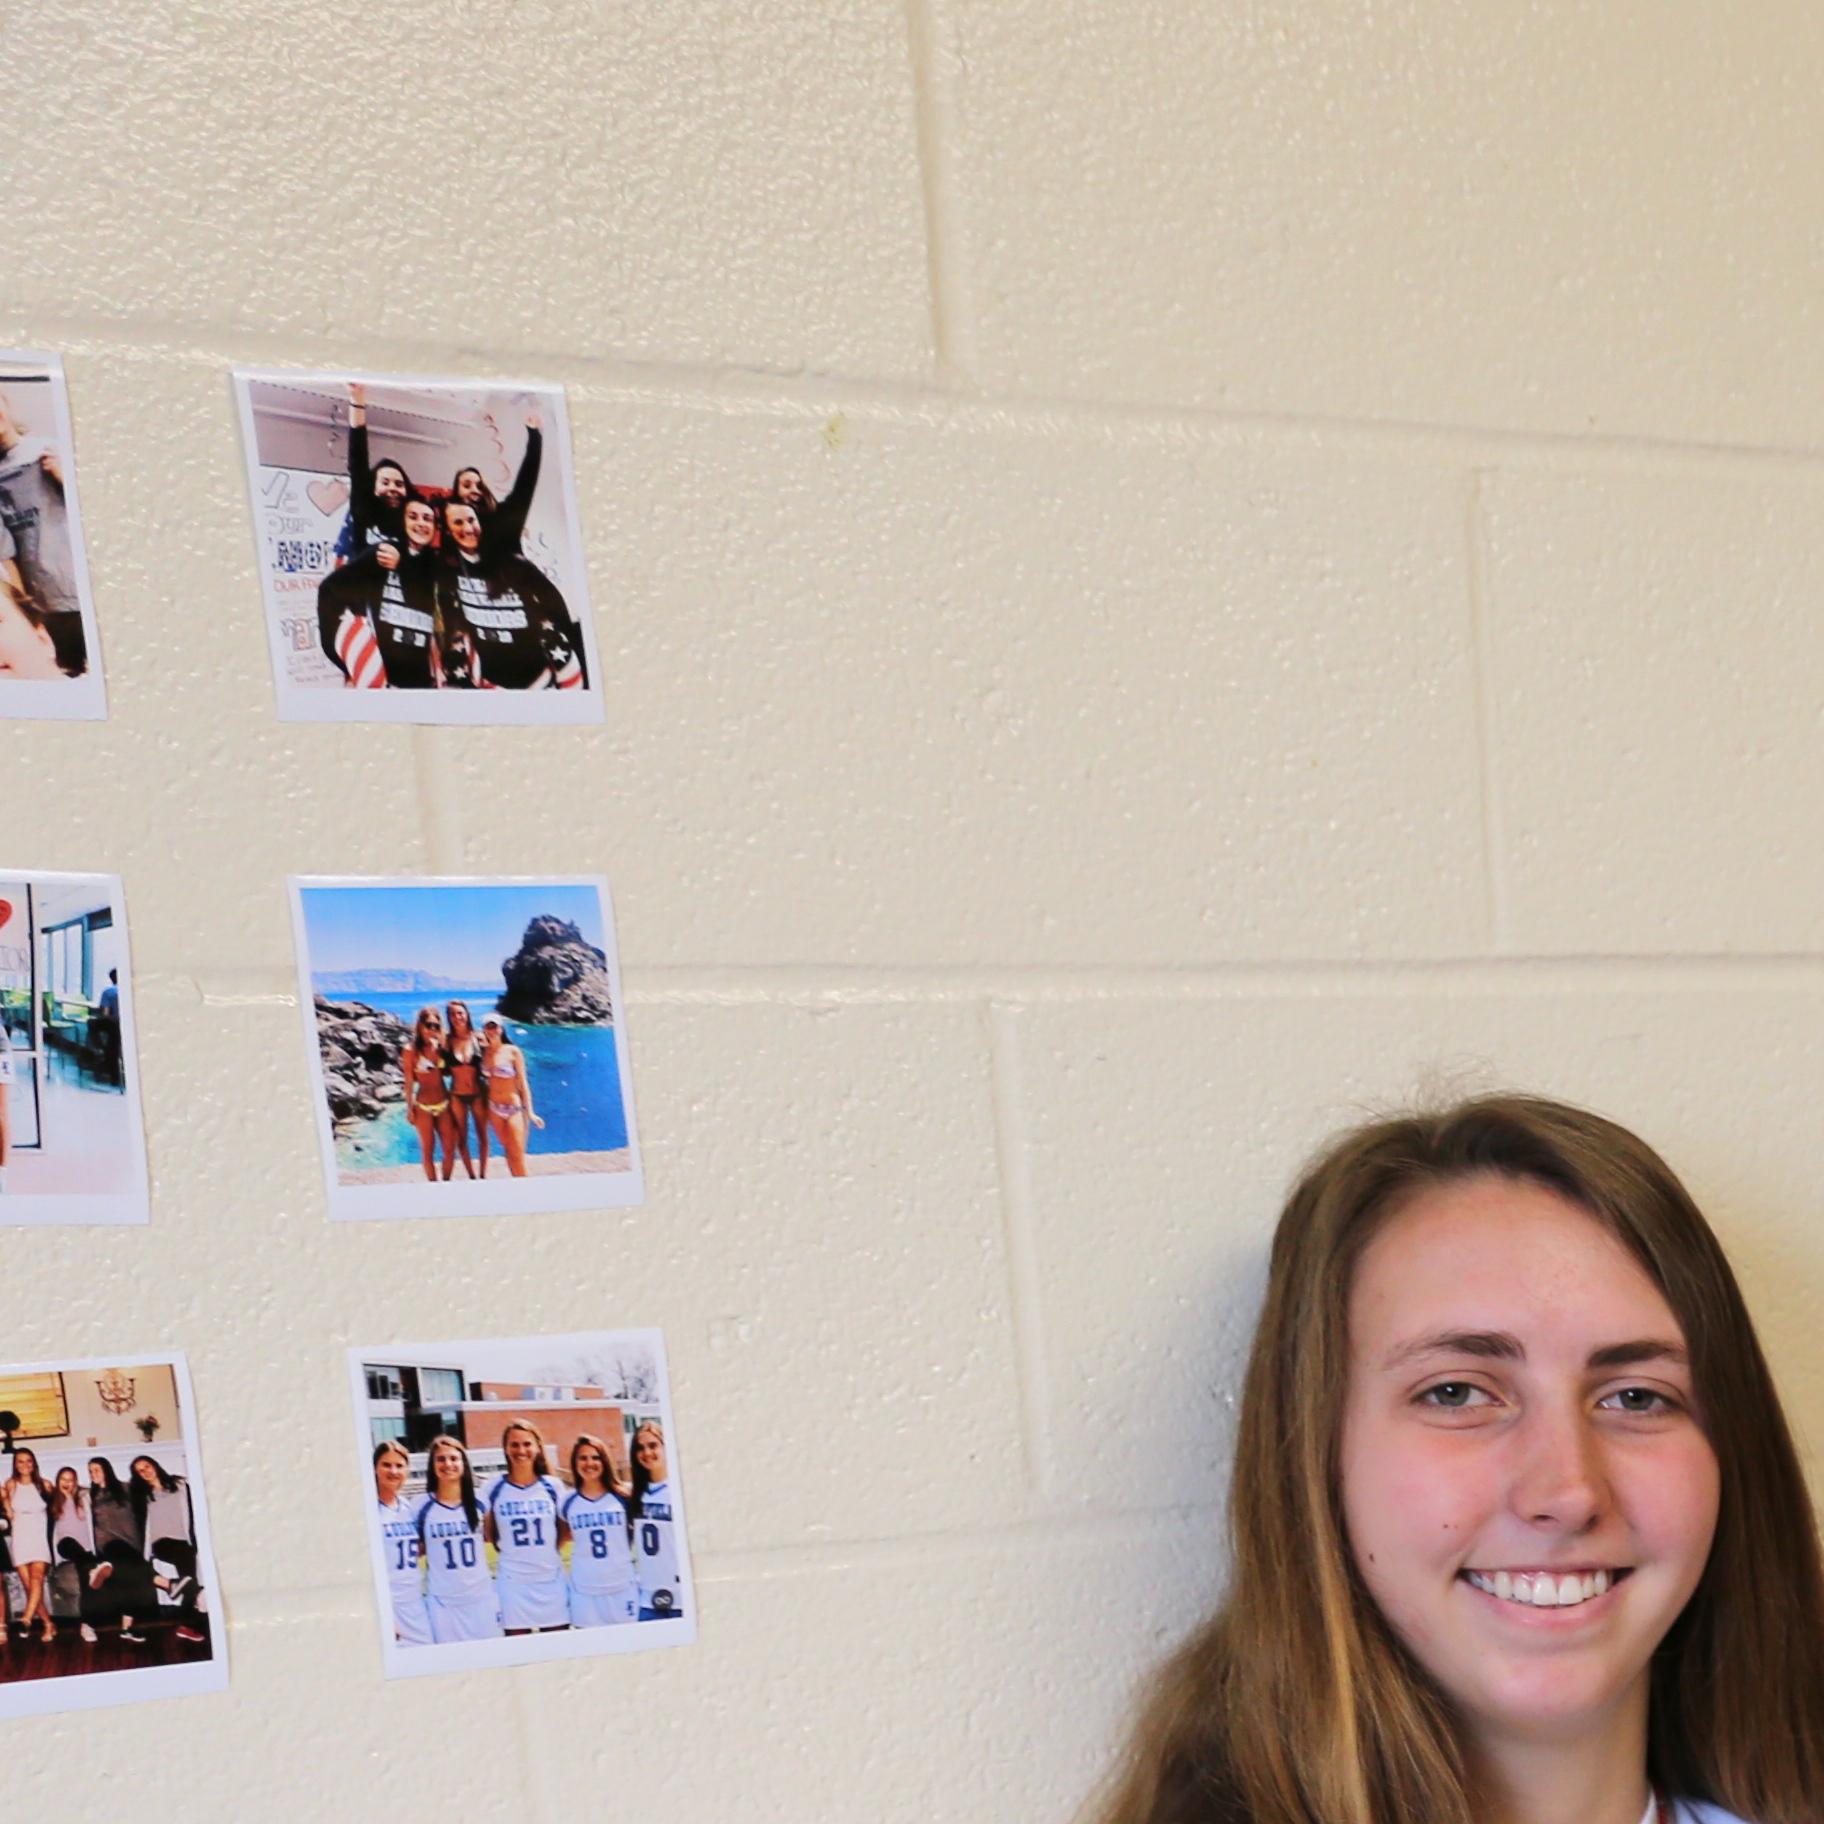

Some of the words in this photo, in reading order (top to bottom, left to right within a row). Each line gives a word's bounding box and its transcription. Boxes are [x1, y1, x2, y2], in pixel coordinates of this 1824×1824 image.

[510, 1517, 545, 1547] 21
[590, 1529, 608, 1559] 8
[642, 1523, 660, 1557] 0
[443, 1538, 477, 1570] 10
